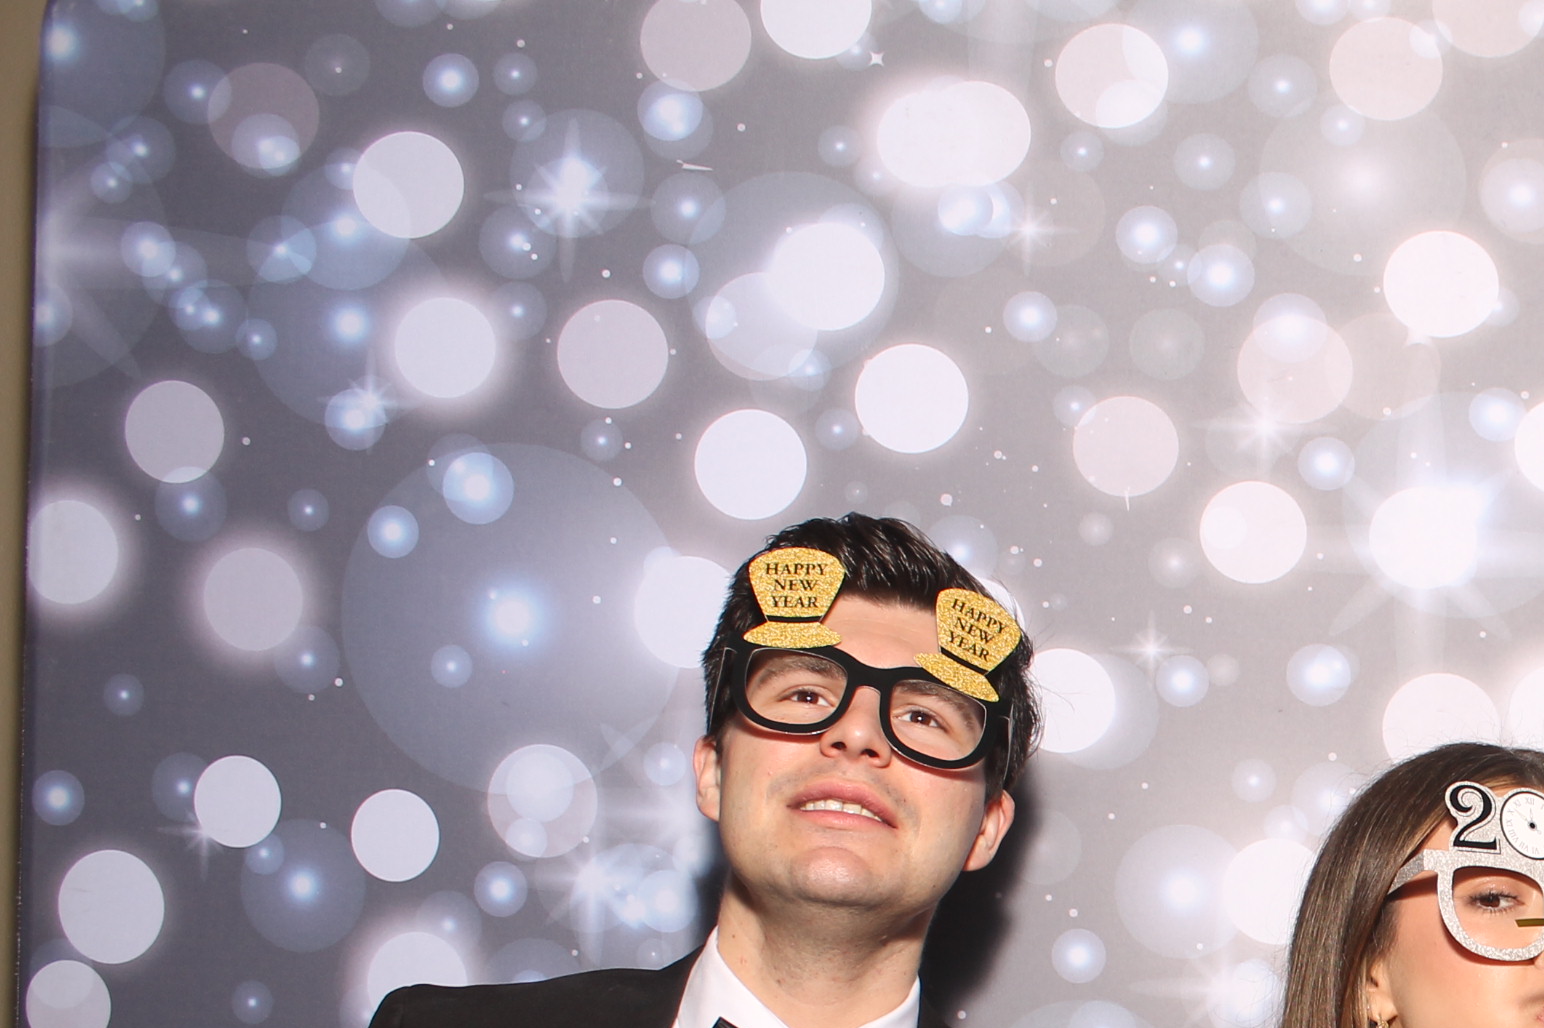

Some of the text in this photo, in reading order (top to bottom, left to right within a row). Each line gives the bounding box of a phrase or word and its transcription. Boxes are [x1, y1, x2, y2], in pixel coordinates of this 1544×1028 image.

[765, 561, 829, 576] HAPPY
[773, 578, 819, 592] NEW
[770, 595, 819, 609] YEAR
[951, 597, 1006, 635] HAPPY
[954, 616, 995, 644] NEW
[949, 631, 990, 662] YEAR
